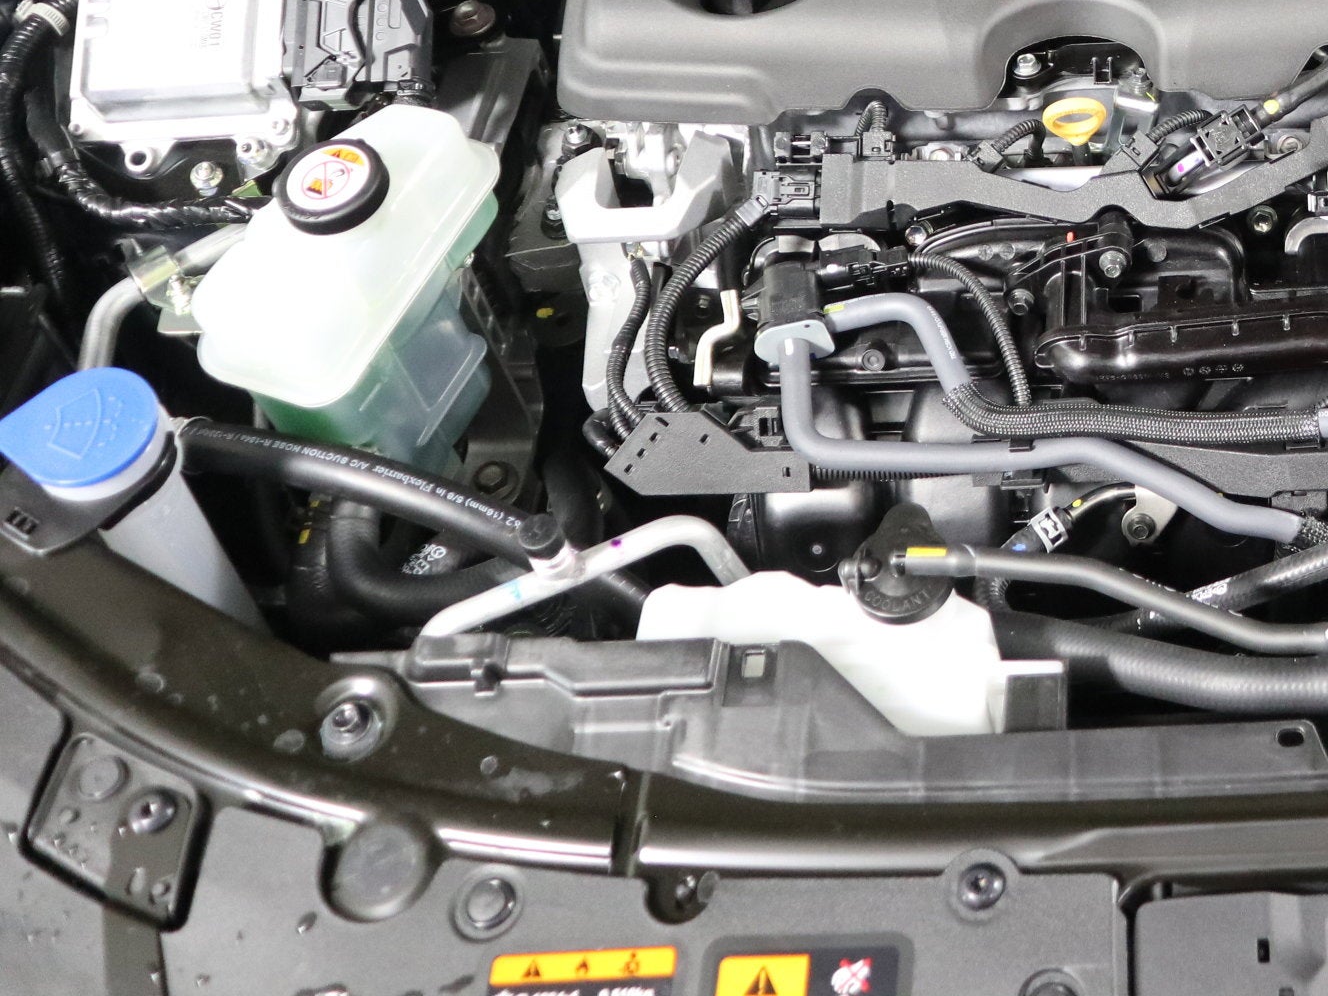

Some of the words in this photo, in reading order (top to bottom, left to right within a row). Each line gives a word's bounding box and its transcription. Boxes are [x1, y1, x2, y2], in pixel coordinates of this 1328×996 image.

[271, 440, 301, 453] HOSE
[300, 447, 349, 464] SUCTION
[349, 459, 370, 470] A/C
[371, 465, 435, 492] Flexbarrier
[864, 589, 931, 612] COOLANT
